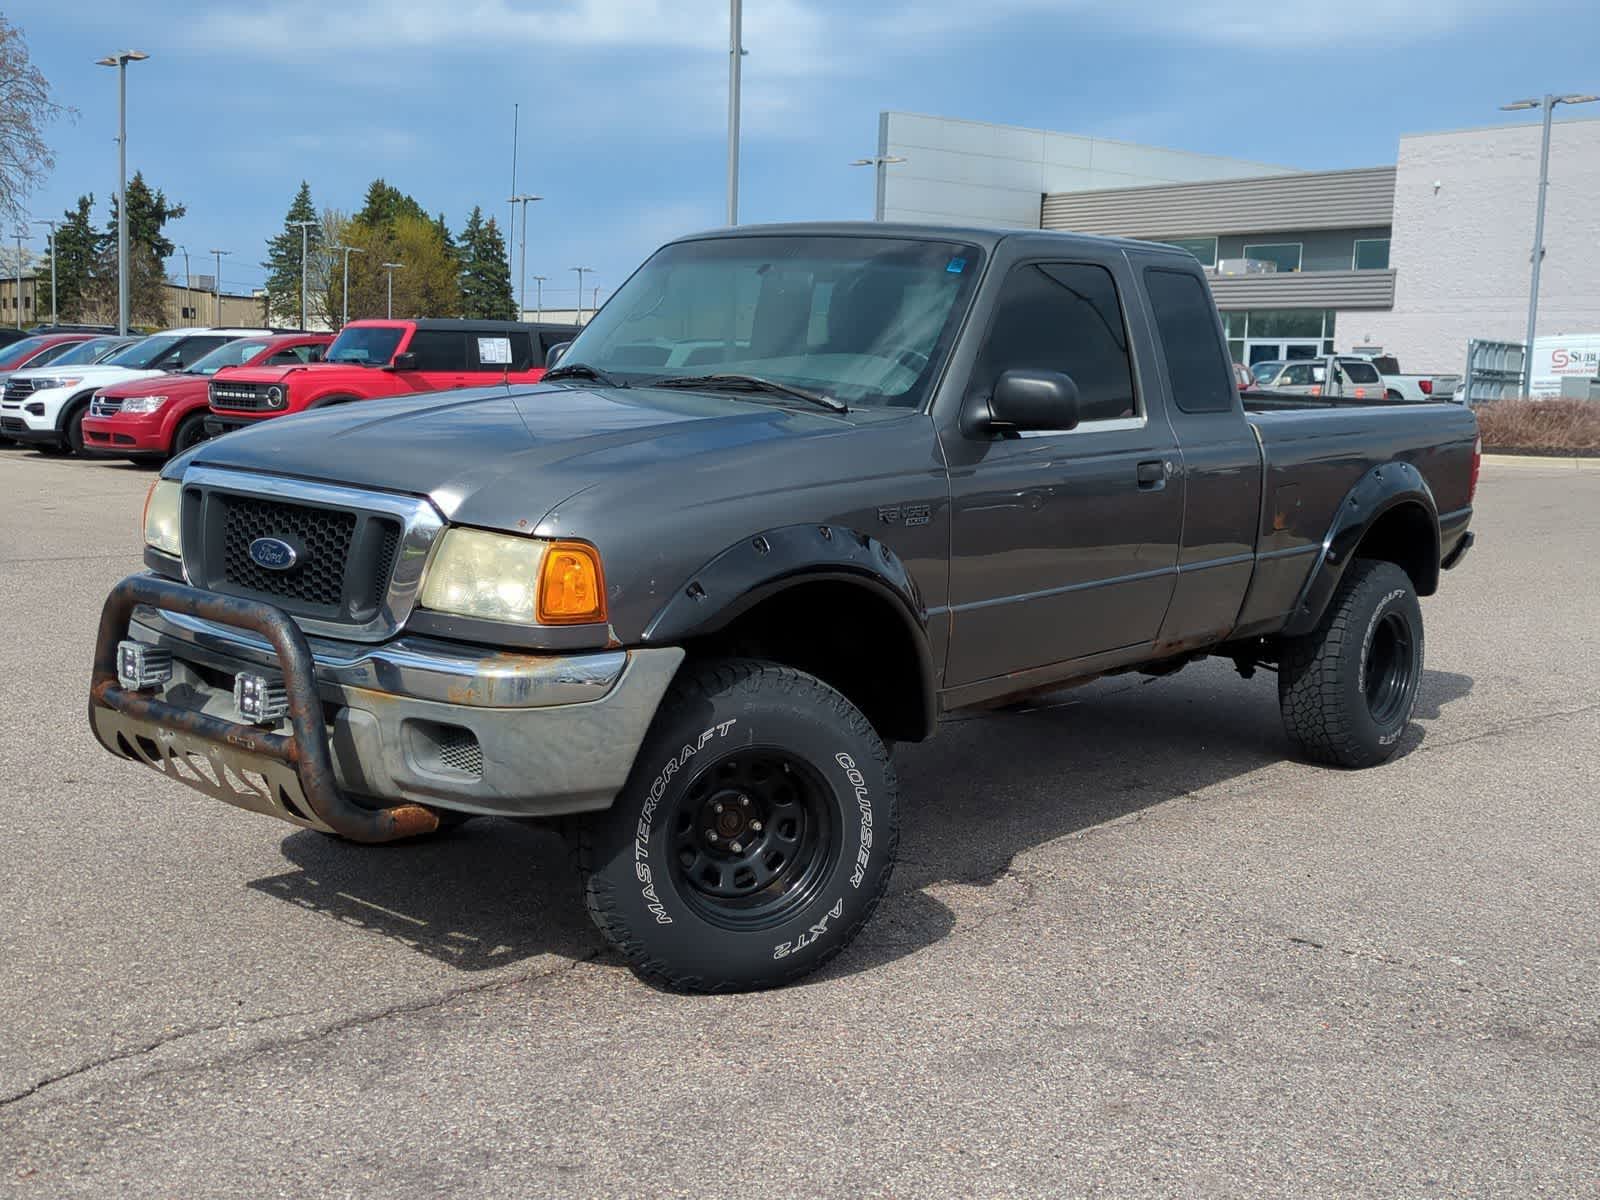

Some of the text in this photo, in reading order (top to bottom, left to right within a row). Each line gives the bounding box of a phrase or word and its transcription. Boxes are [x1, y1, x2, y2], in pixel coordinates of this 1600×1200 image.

[258, 542, 285, 564] Ford
[634, 718, 737, 926] MASTERCRAFT
[834, 751, 874, 890] COURSER
[772, 897, 843, 960] AXT2
